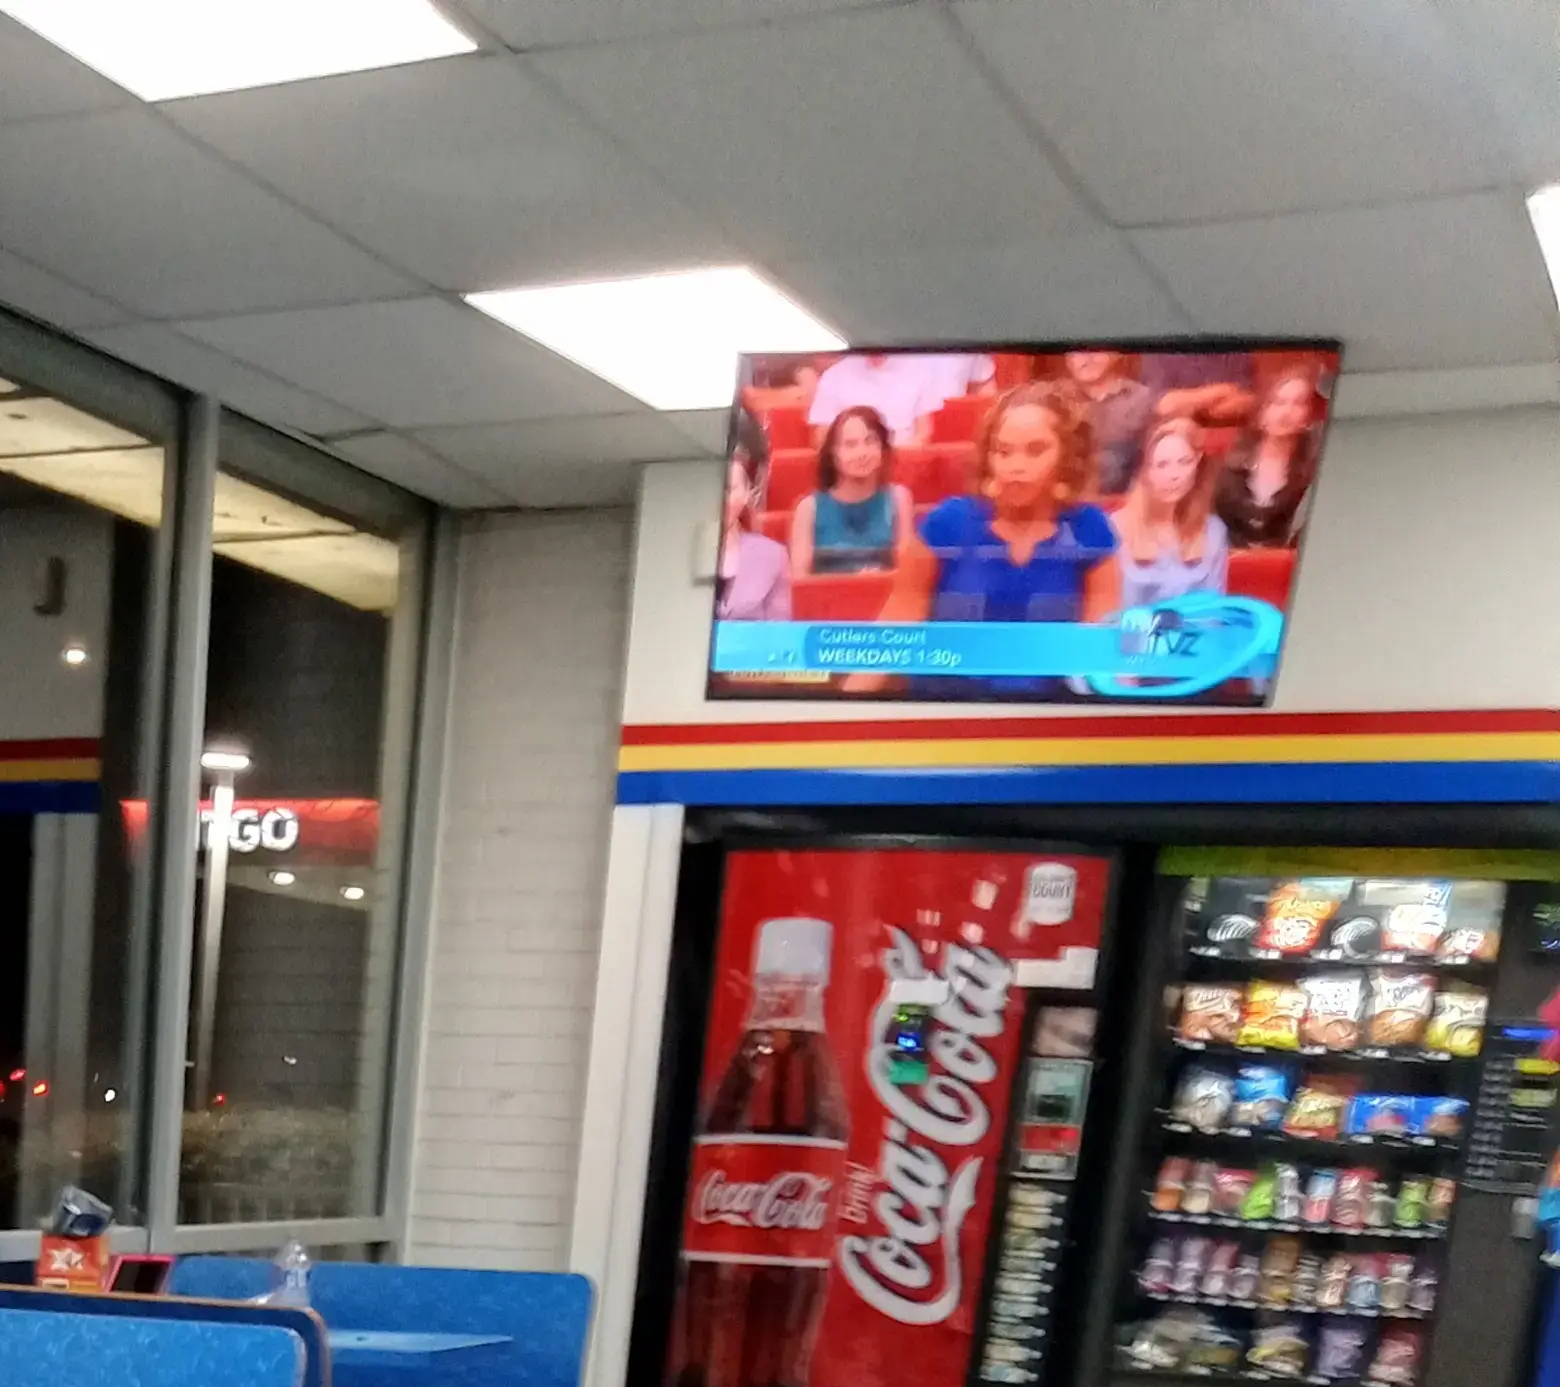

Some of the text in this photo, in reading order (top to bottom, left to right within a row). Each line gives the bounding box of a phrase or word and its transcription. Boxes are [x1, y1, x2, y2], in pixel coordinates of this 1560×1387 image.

[881, 629, 927, 645] Court
[818, 647, 912, 666] WEEKDAYS
[838, 924, 1011, 1325] Coca-Cola
